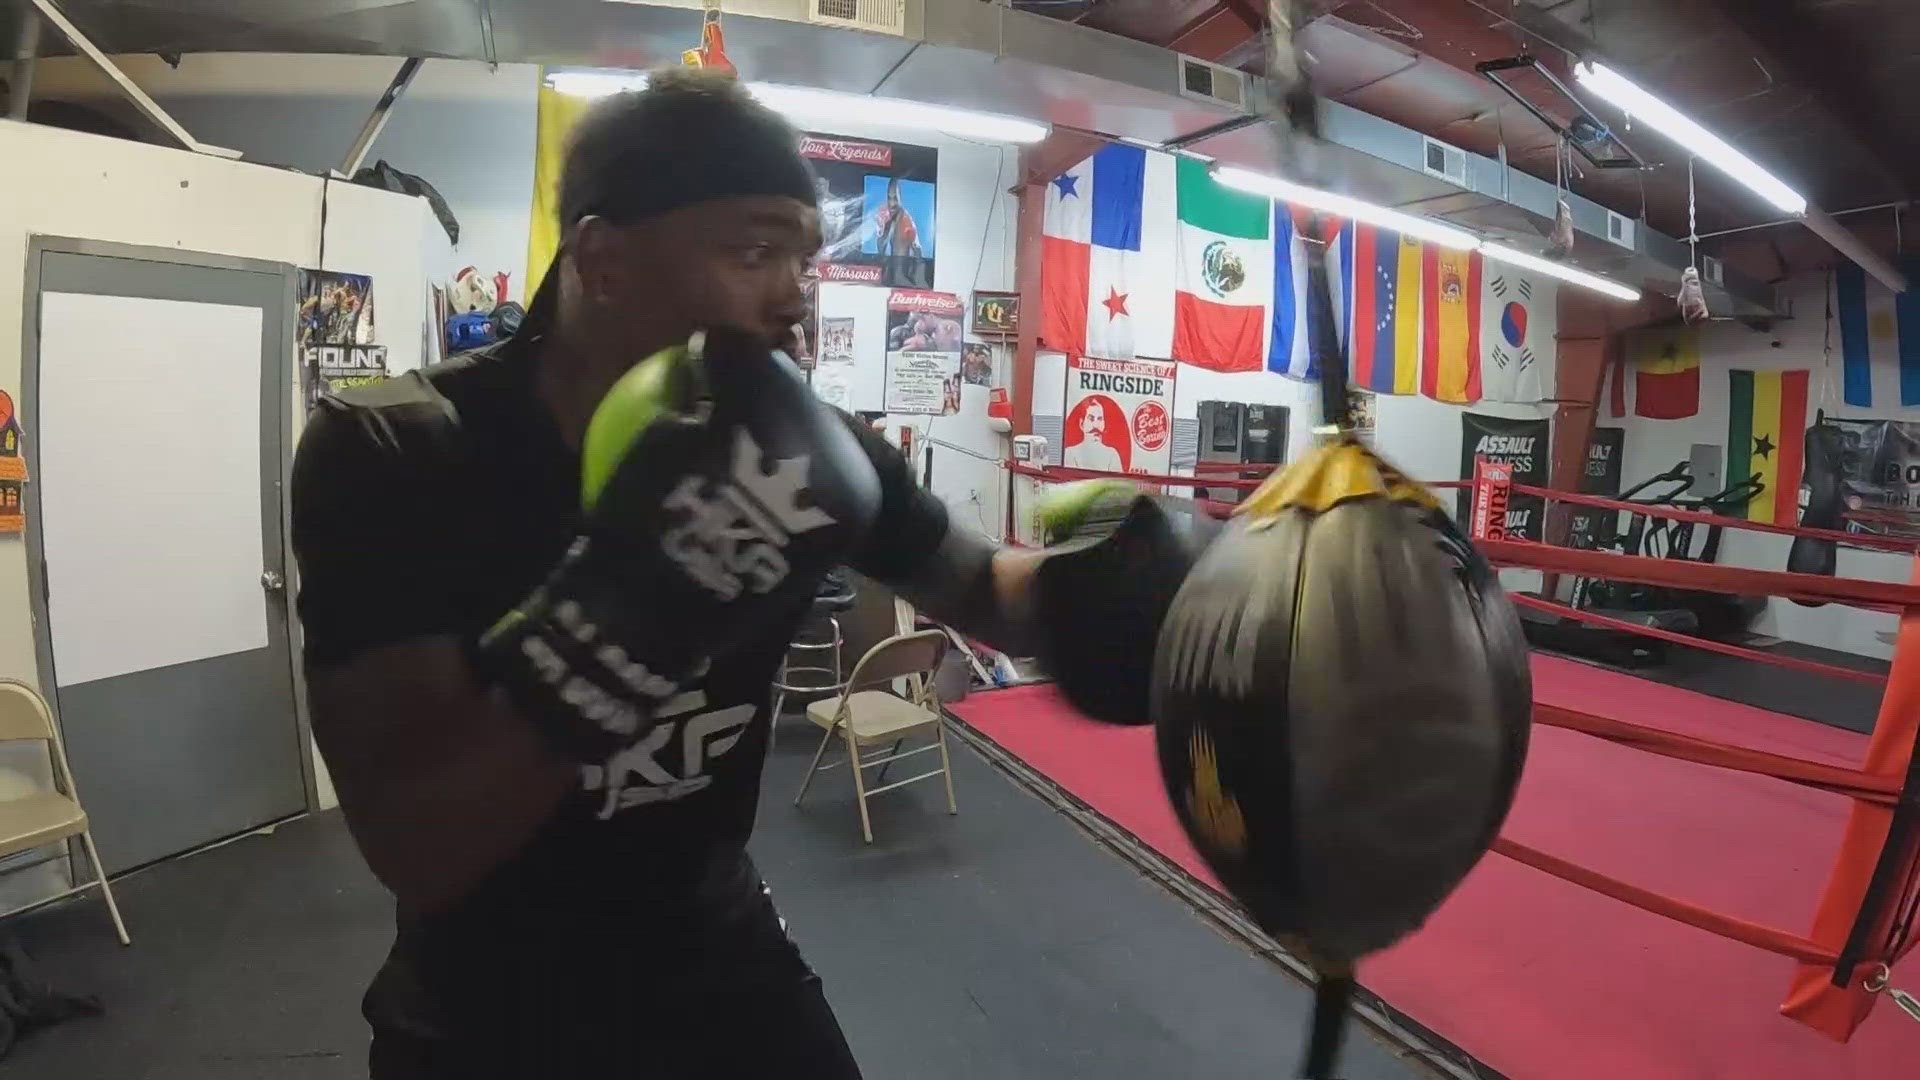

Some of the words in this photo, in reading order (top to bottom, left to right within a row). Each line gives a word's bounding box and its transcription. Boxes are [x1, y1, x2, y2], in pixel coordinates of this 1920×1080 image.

[827, 140, 889, 161] Legends!
[827, 264, 881, 281] Missouri
[889, 292, 961, 309] Budweiser
[1078, 358, 1095, 369] THE
[1095, 359, 1123, 372] SWEET
[1124, 362, 1156, 375] SCIENCE
[1080, 372, 1164, 396] RINGSIDE
[1138, 413, 1165, 429] Best
[1476, 435, 1536, 454] ASSAULT
